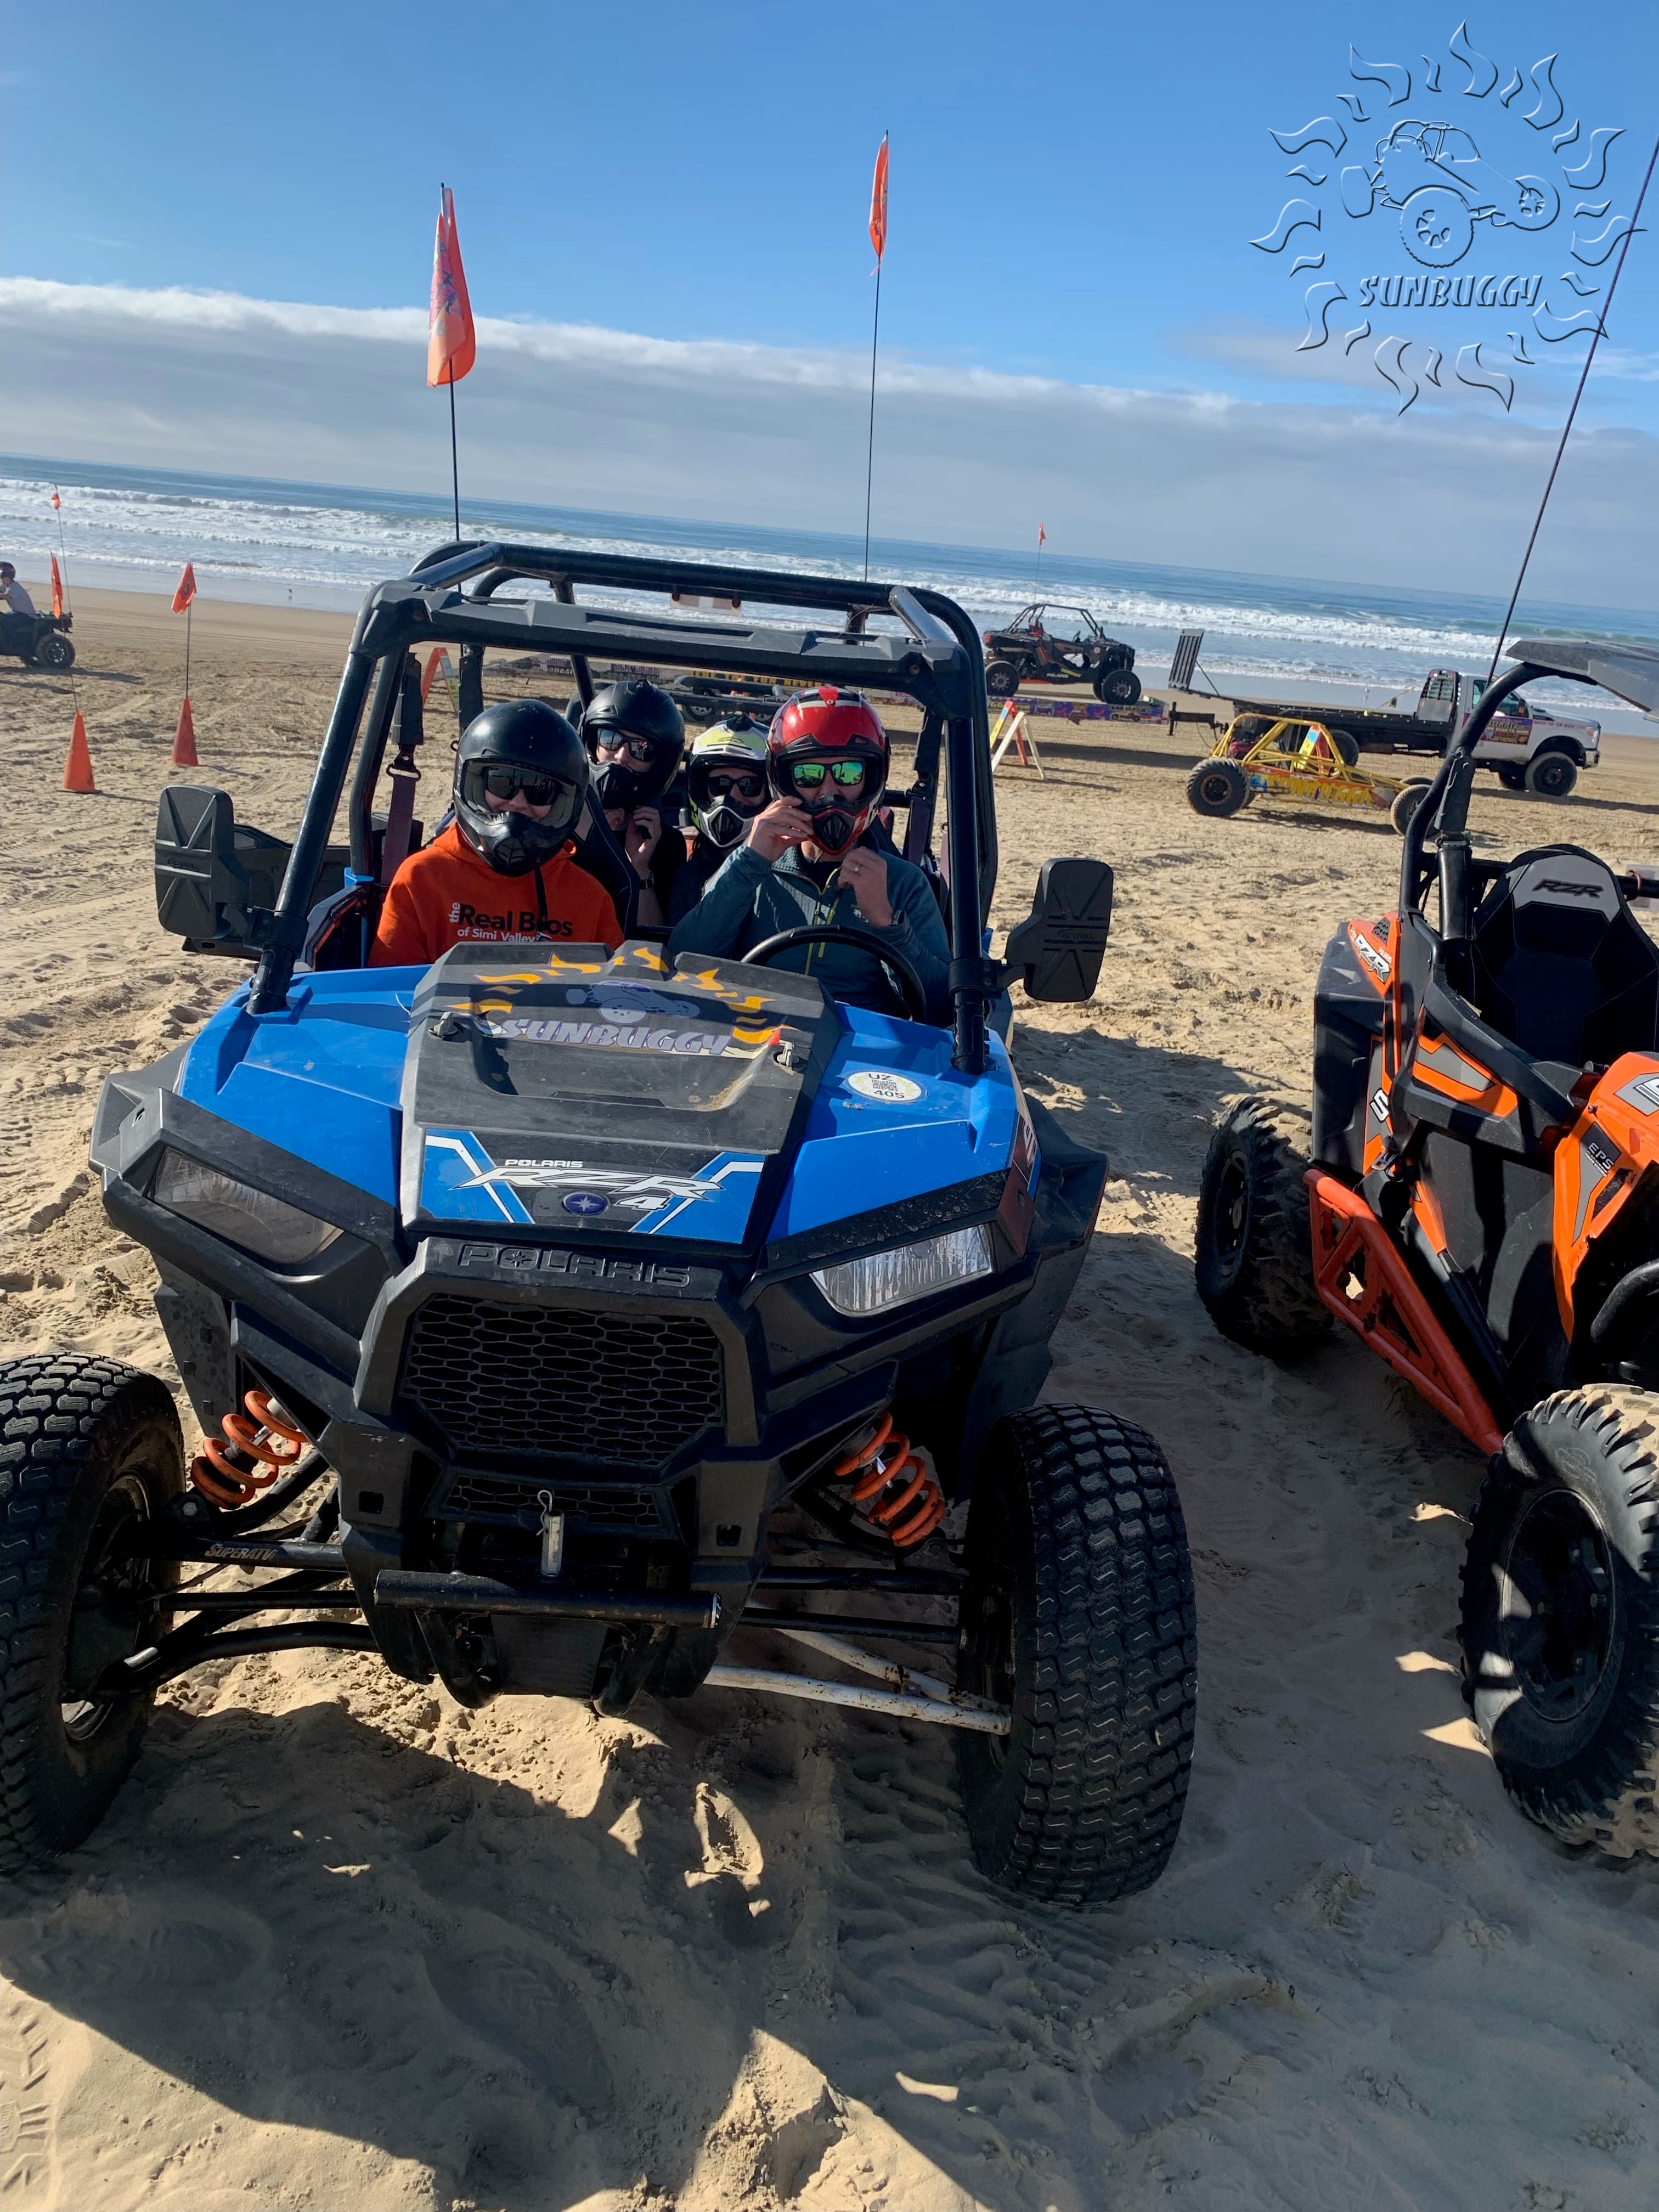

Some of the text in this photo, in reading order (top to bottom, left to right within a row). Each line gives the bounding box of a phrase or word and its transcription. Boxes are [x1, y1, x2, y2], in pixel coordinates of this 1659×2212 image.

[1532, 878, 1605, 899] RZR
[448, 901, 461, 923] the
[459, 903, 514, 932] Real
[457, 927, 536, 943] of Simi Valley
[1354, 932, 1392, 985] RZR
[500, 1018, 732, 1055] SUNBUGGY
[868, 1073, 893, 1081] UZ
[874, 1090, 905, 1098] 405
[504, 1159, 584, 1169] POLARIS
[1588, 1142, 1615, 1170] EPS
[448, 1166, 726, 1201] RZR
[614, 1194, 670, 1211] 4
[456, 1243, 691, 1288] POLARIS
